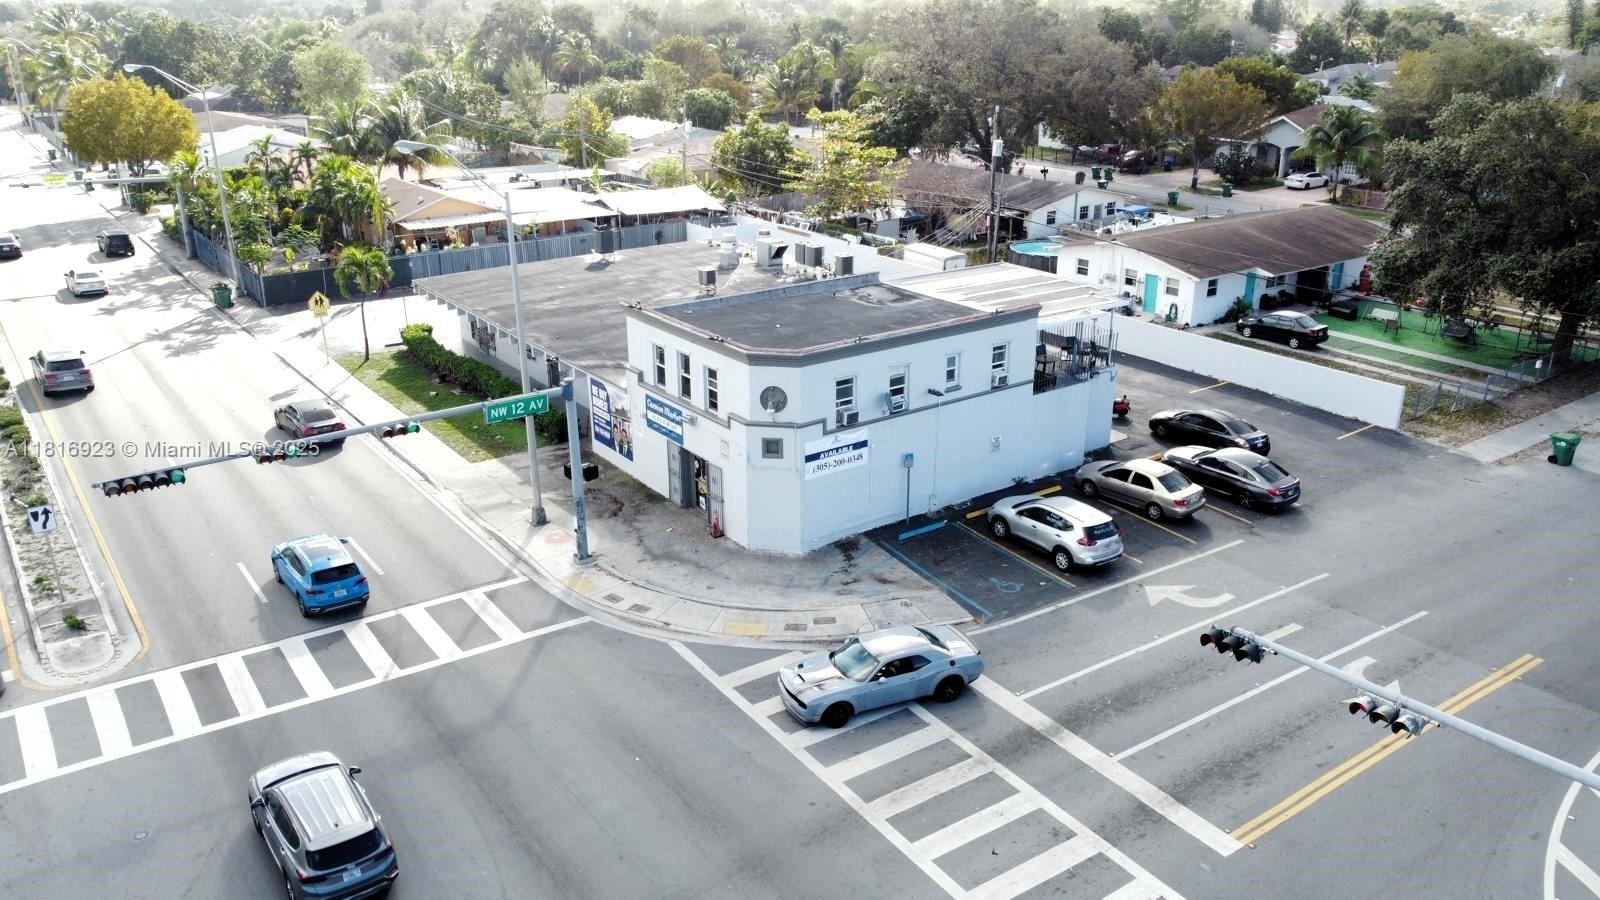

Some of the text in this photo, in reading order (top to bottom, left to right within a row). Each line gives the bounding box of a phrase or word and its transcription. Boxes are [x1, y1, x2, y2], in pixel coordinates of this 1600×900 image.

[491, 399, 544, 418] NW 12 AV
[820, 445, 854, 460] AVAILABLE
